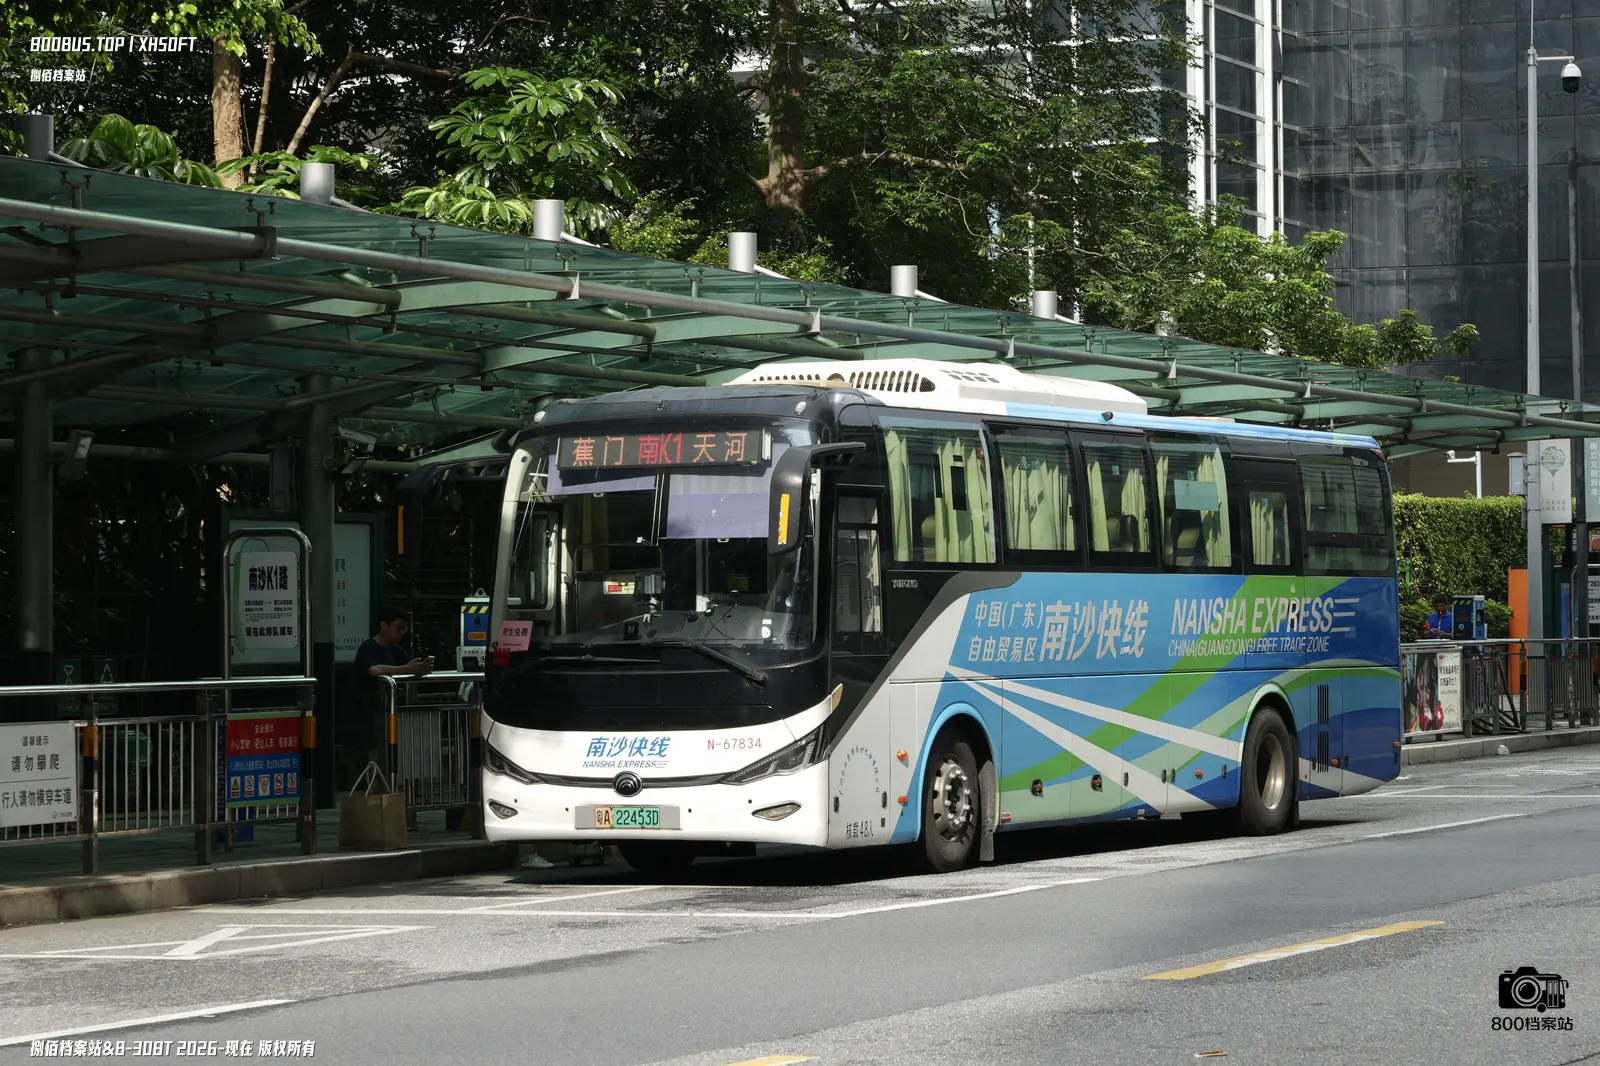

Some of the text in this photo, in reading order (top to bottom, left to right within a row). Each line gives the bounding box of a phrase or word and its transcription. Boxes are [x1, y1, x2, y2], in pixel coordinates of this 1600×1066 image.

[572, 432, 748, 467] 蕉门 南K1 天河
[248, 565, 288, 591] 南沙K1路
[891, 579, 919, 589] YUTONG
[1171, 596, 1335, 636] NANSHA EXPRESS
[502, 627, 529, 637] 考生免费
[1039, 599, 1149, 662] 南沙快线
[968, 635, 1040, 662] 自由贸易区
[1280, 637, 1307, 652] TRADE
[1307, 636, 1331, 652] ZONE
[21, 735, 49, 747] 温馨提示
[586, 736, 671, 758] 南沙快线
[706, 737, 763, 751] N-67834
[11, 753, 60, 773] 请勿攀爬
[582, 760, 658, 769] NANSHA EXPRESS
[1, 787, 73, 809] 行人请勿横穿车道
